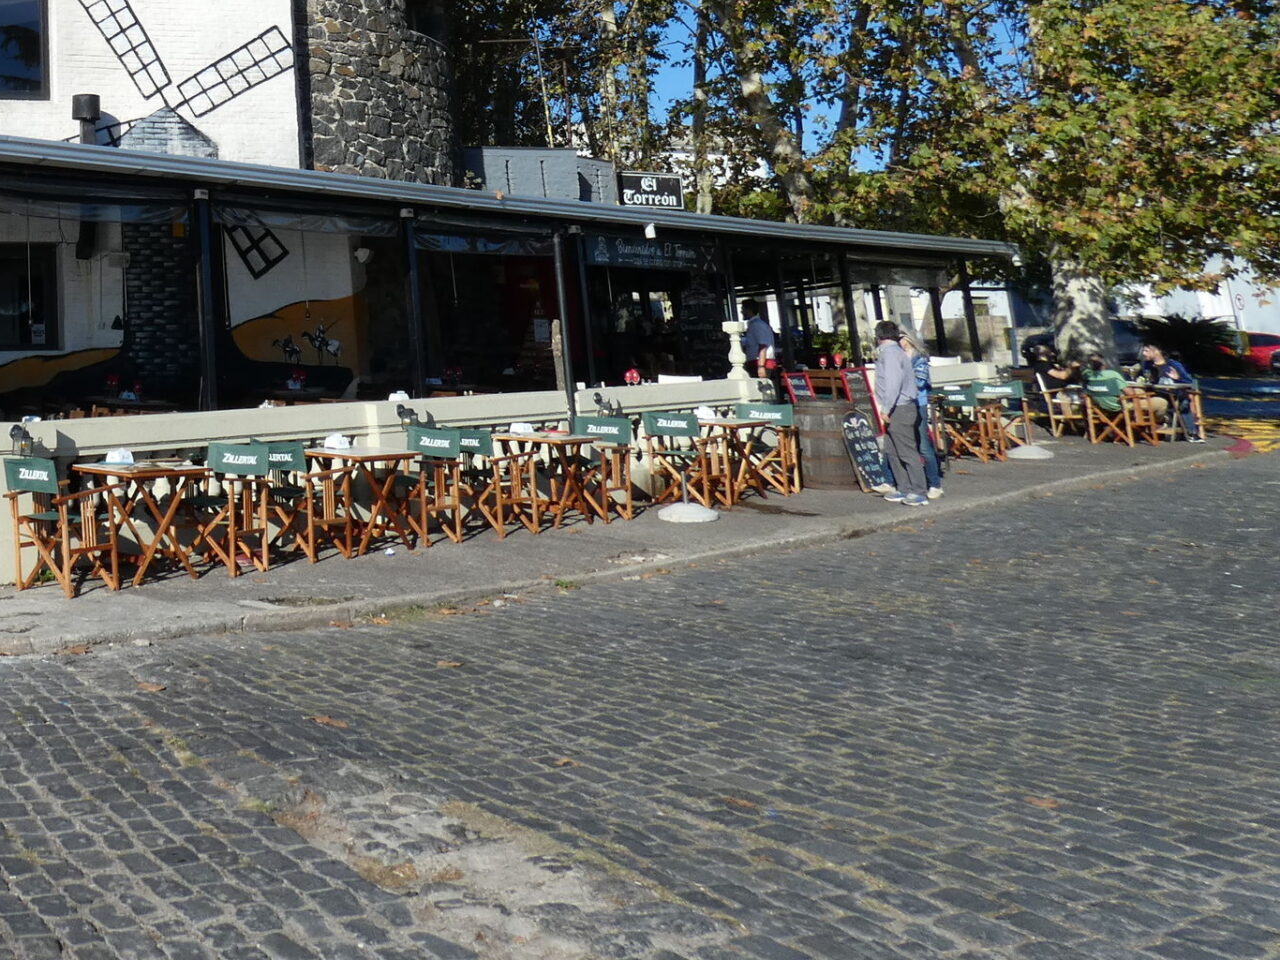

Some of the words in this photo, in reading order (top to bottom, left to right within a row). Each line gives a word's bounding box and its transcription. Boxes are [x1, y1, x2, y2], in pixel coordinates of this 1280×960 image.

[640, 177, 658, 191] El
[623, 190, 678, 207] Torreón
[222, 452, 258, 465] ZILLERTAL
